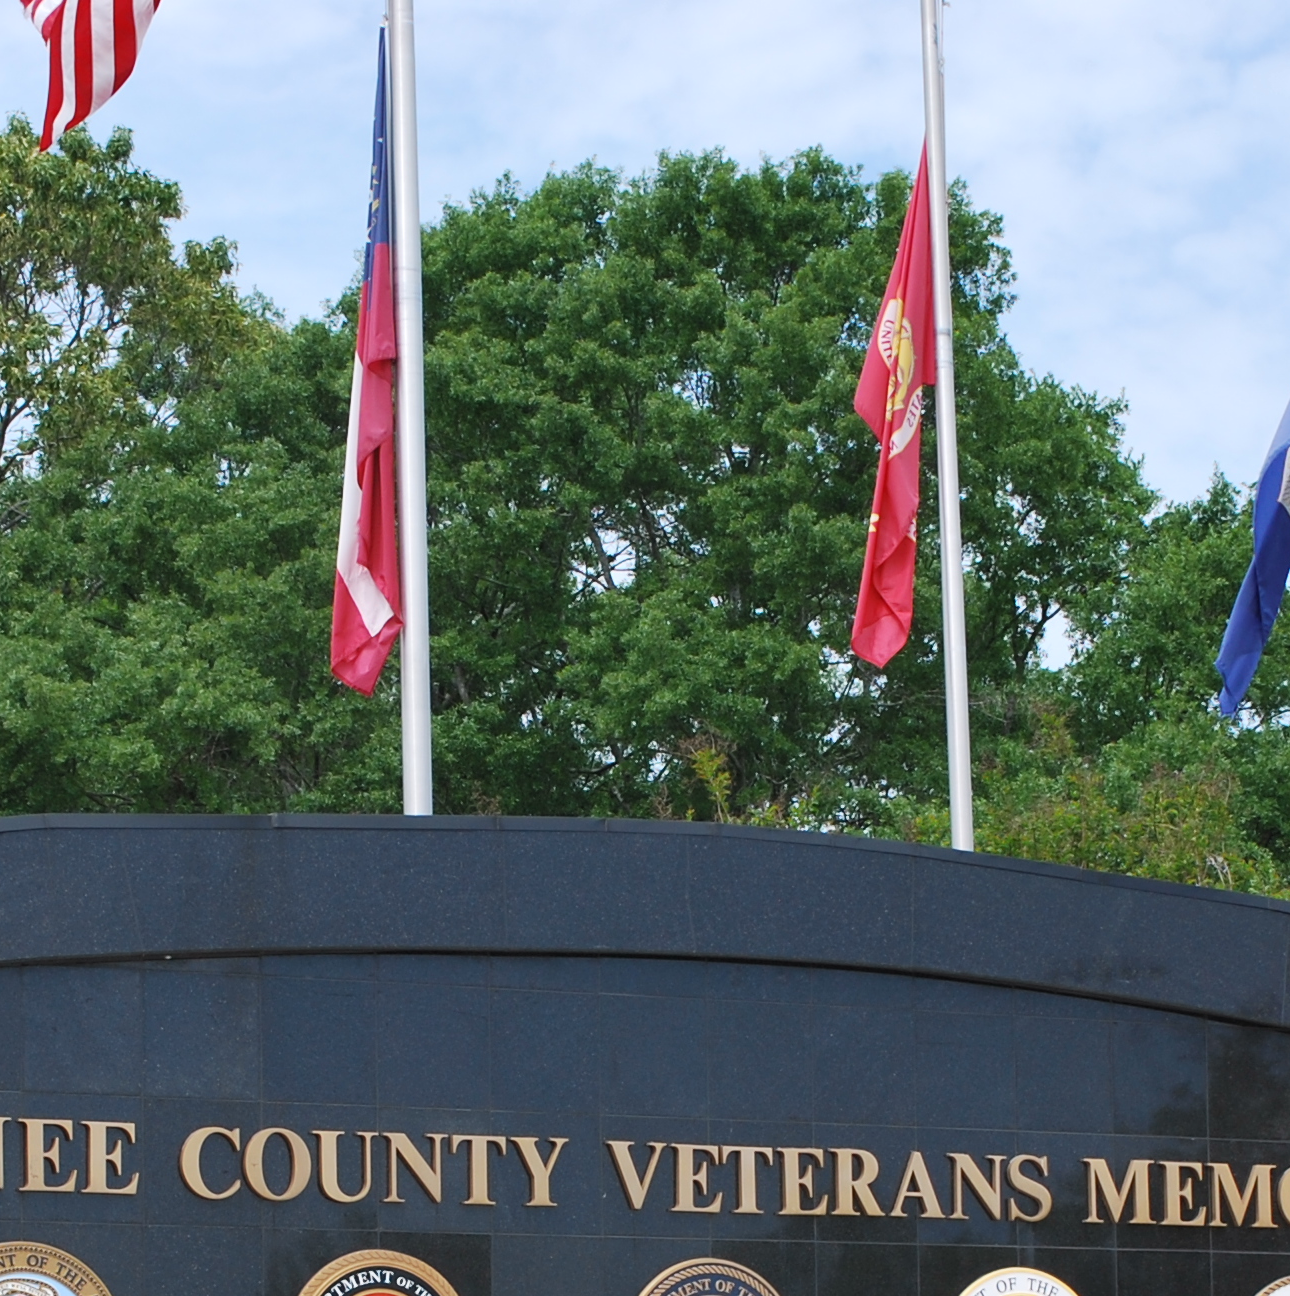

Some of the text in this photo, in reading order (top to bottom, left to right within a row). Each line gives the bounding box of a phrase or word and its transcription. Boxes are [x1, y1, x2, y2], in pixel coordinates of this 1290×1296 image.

[179, 1125, 570, 1208] COUNTY
[605, 1140, 1053, 1223] VETERANS
[27, 1254, 49, 1269] OF
[56, 1262, 86, 1291] THE
[396, 1276, 415, 1289] OF
[715, 1279, 735, 1293] OF
[996, 1277, 1017, 1293] OF
